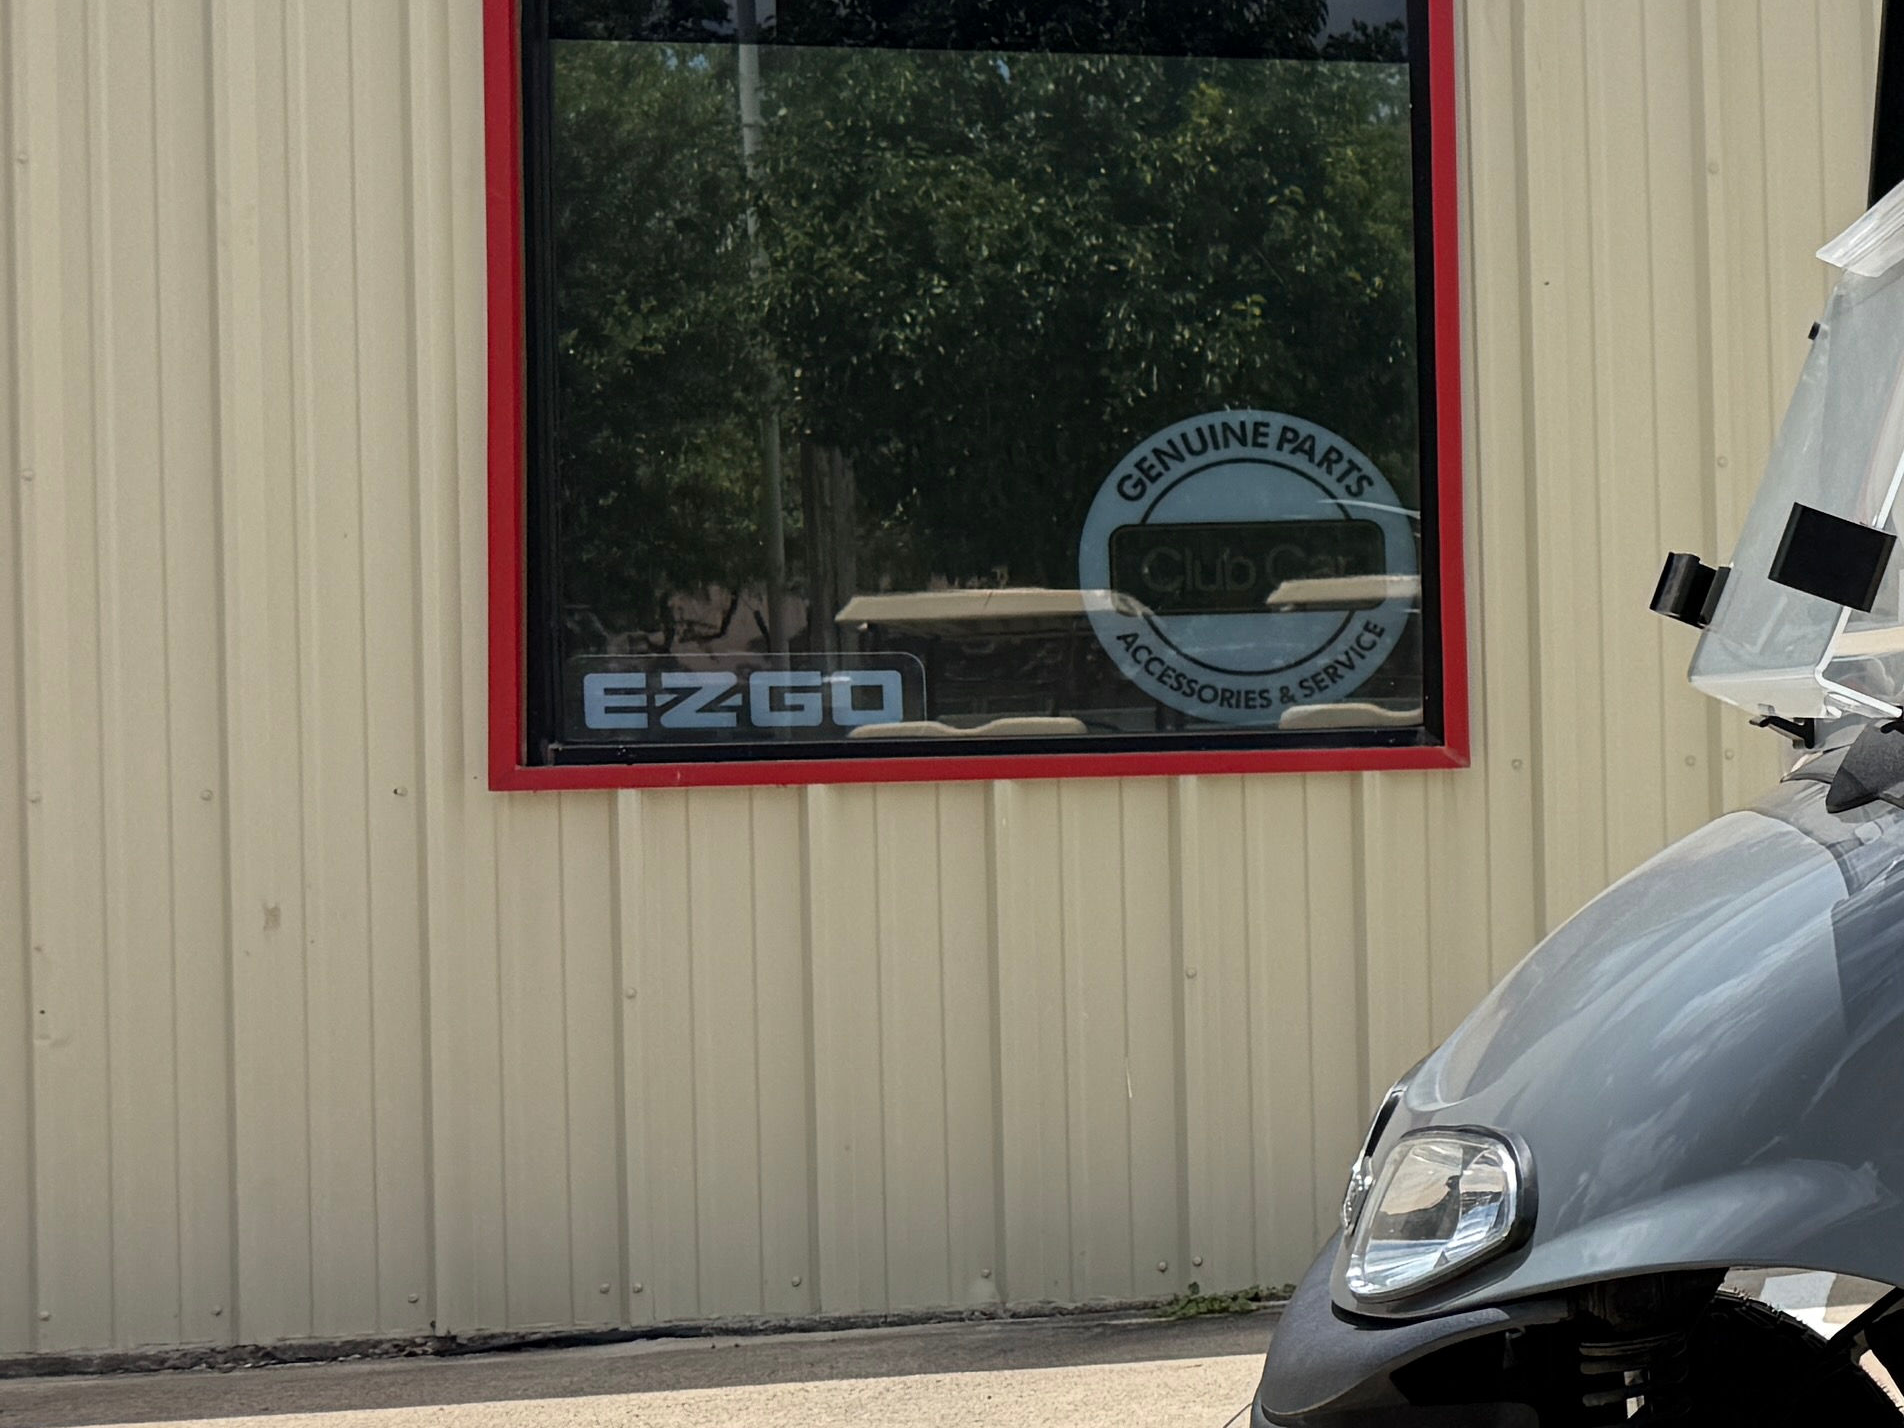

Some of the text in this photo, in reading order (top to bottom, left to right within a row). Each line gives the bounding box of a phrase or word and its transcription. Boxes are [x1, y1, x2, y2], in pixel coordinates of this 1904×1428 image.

[1116, 420, 1375, 502] GENUINE PARTS
[1115, 620, 1386, 710] ACCESSORIES & SERVICE
